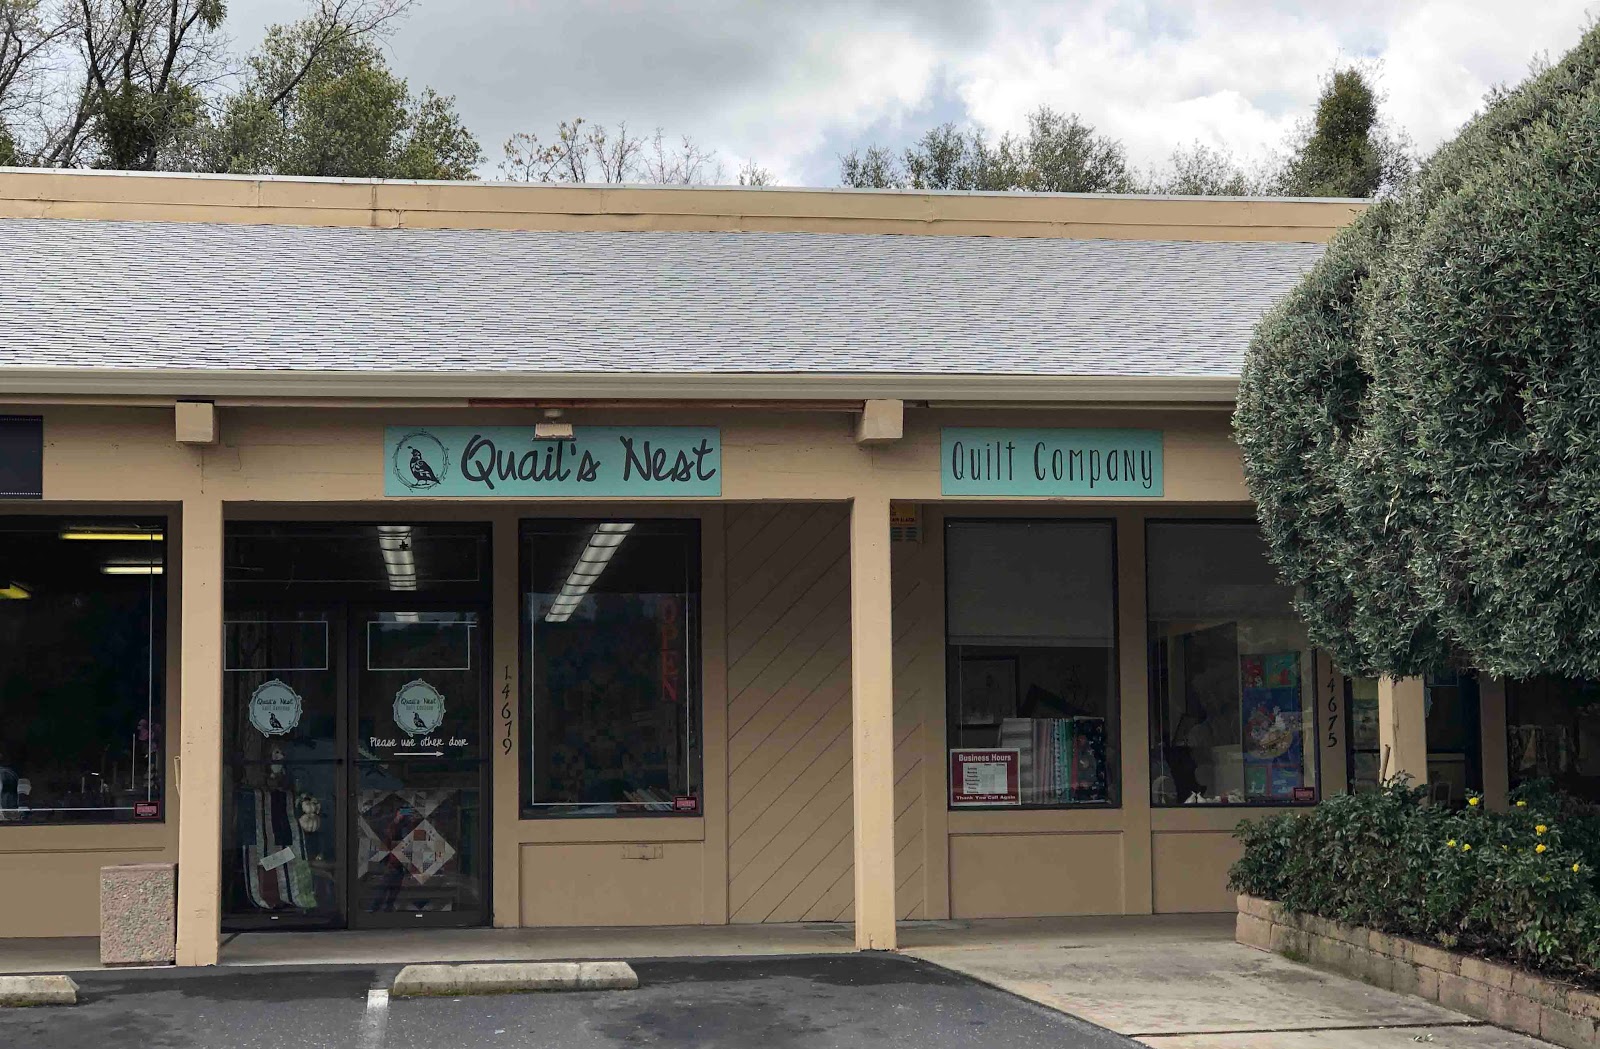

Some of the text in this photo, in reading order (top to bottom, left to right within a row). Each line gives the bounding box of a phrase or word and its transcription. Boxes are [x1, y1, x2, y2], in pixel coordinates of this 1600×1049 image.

[461, 434, 717, 490] Quail's Nest
[952, 441, 1153, 489] Quilt Company
[501, 665, 513, 755] 14679
[1326, 660, 1338, 749] 14675
[369, 736, 469, 747] Please use other door
[958, 753, 1012, 762] Business Hours
